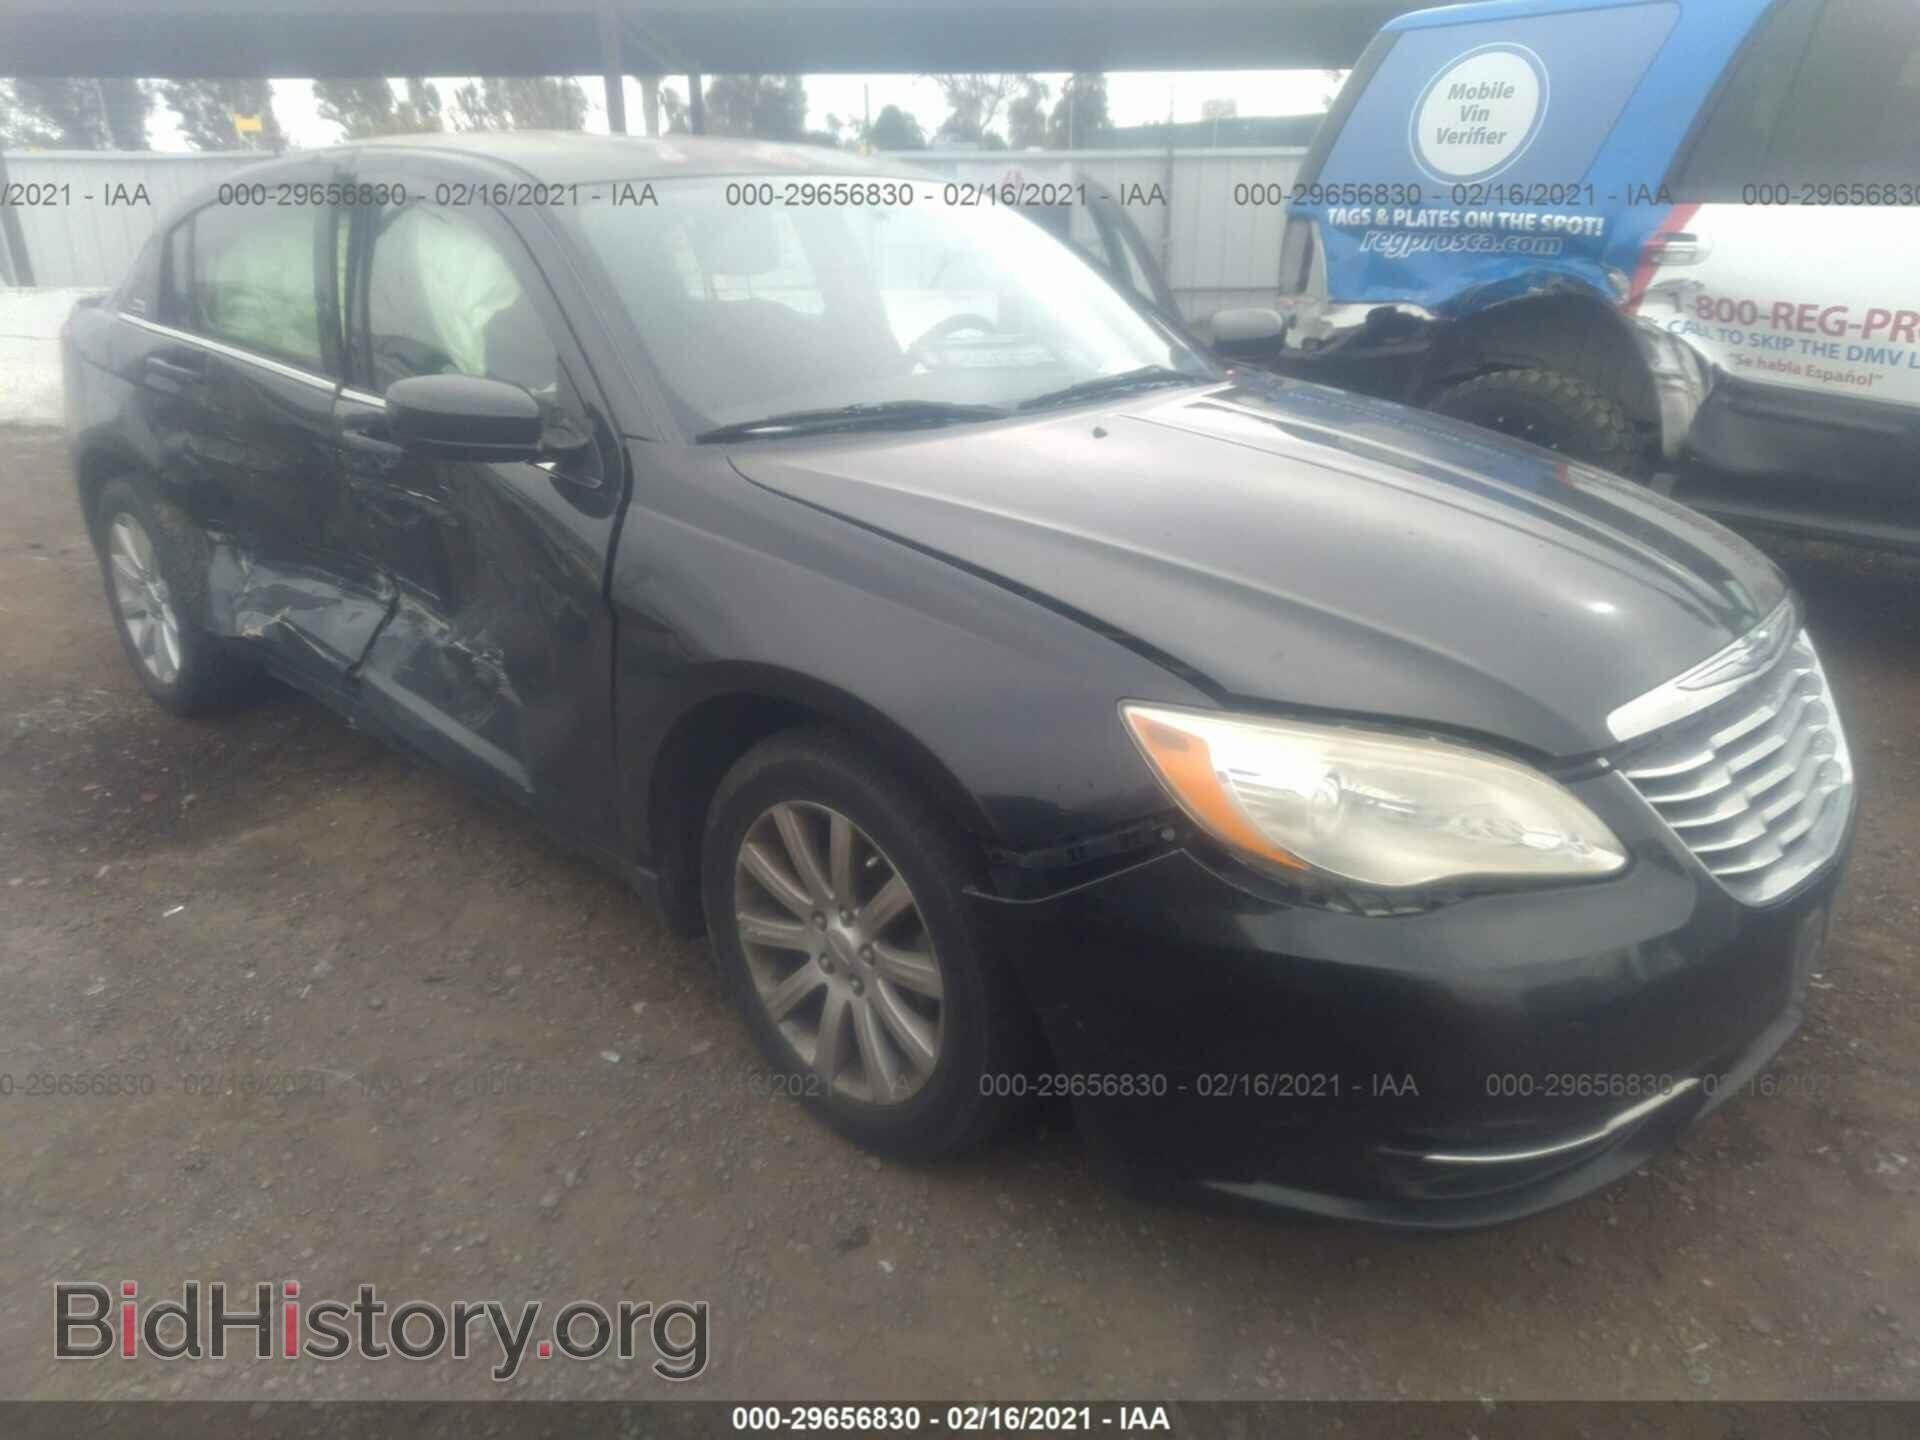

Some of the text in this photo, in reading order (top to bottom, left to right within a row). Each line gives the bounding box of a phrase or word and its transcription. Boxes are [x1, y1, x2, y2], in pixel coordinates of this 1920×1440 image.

[1448, 81, 1515, 100] Mobile
[1459, 104, 1490, 121] Vin
[1436, 126, 1507, 145] Verifier
[1328, 208, 1605, 236] TAGS & PLATES ON THE SPOT!
[1360, 230, 1563, 258] regprosca.com
[1667, 292, 1920, 343] 1-800-REG-PR
[1718, 328, 1744, 344] TO
[1750, 333, 1794, 350] SKIP
[1801, 339, 1841, 359] THE
[1847, 346, 1904, 367] DMV
[1757, 356, 1801, 376] habla
